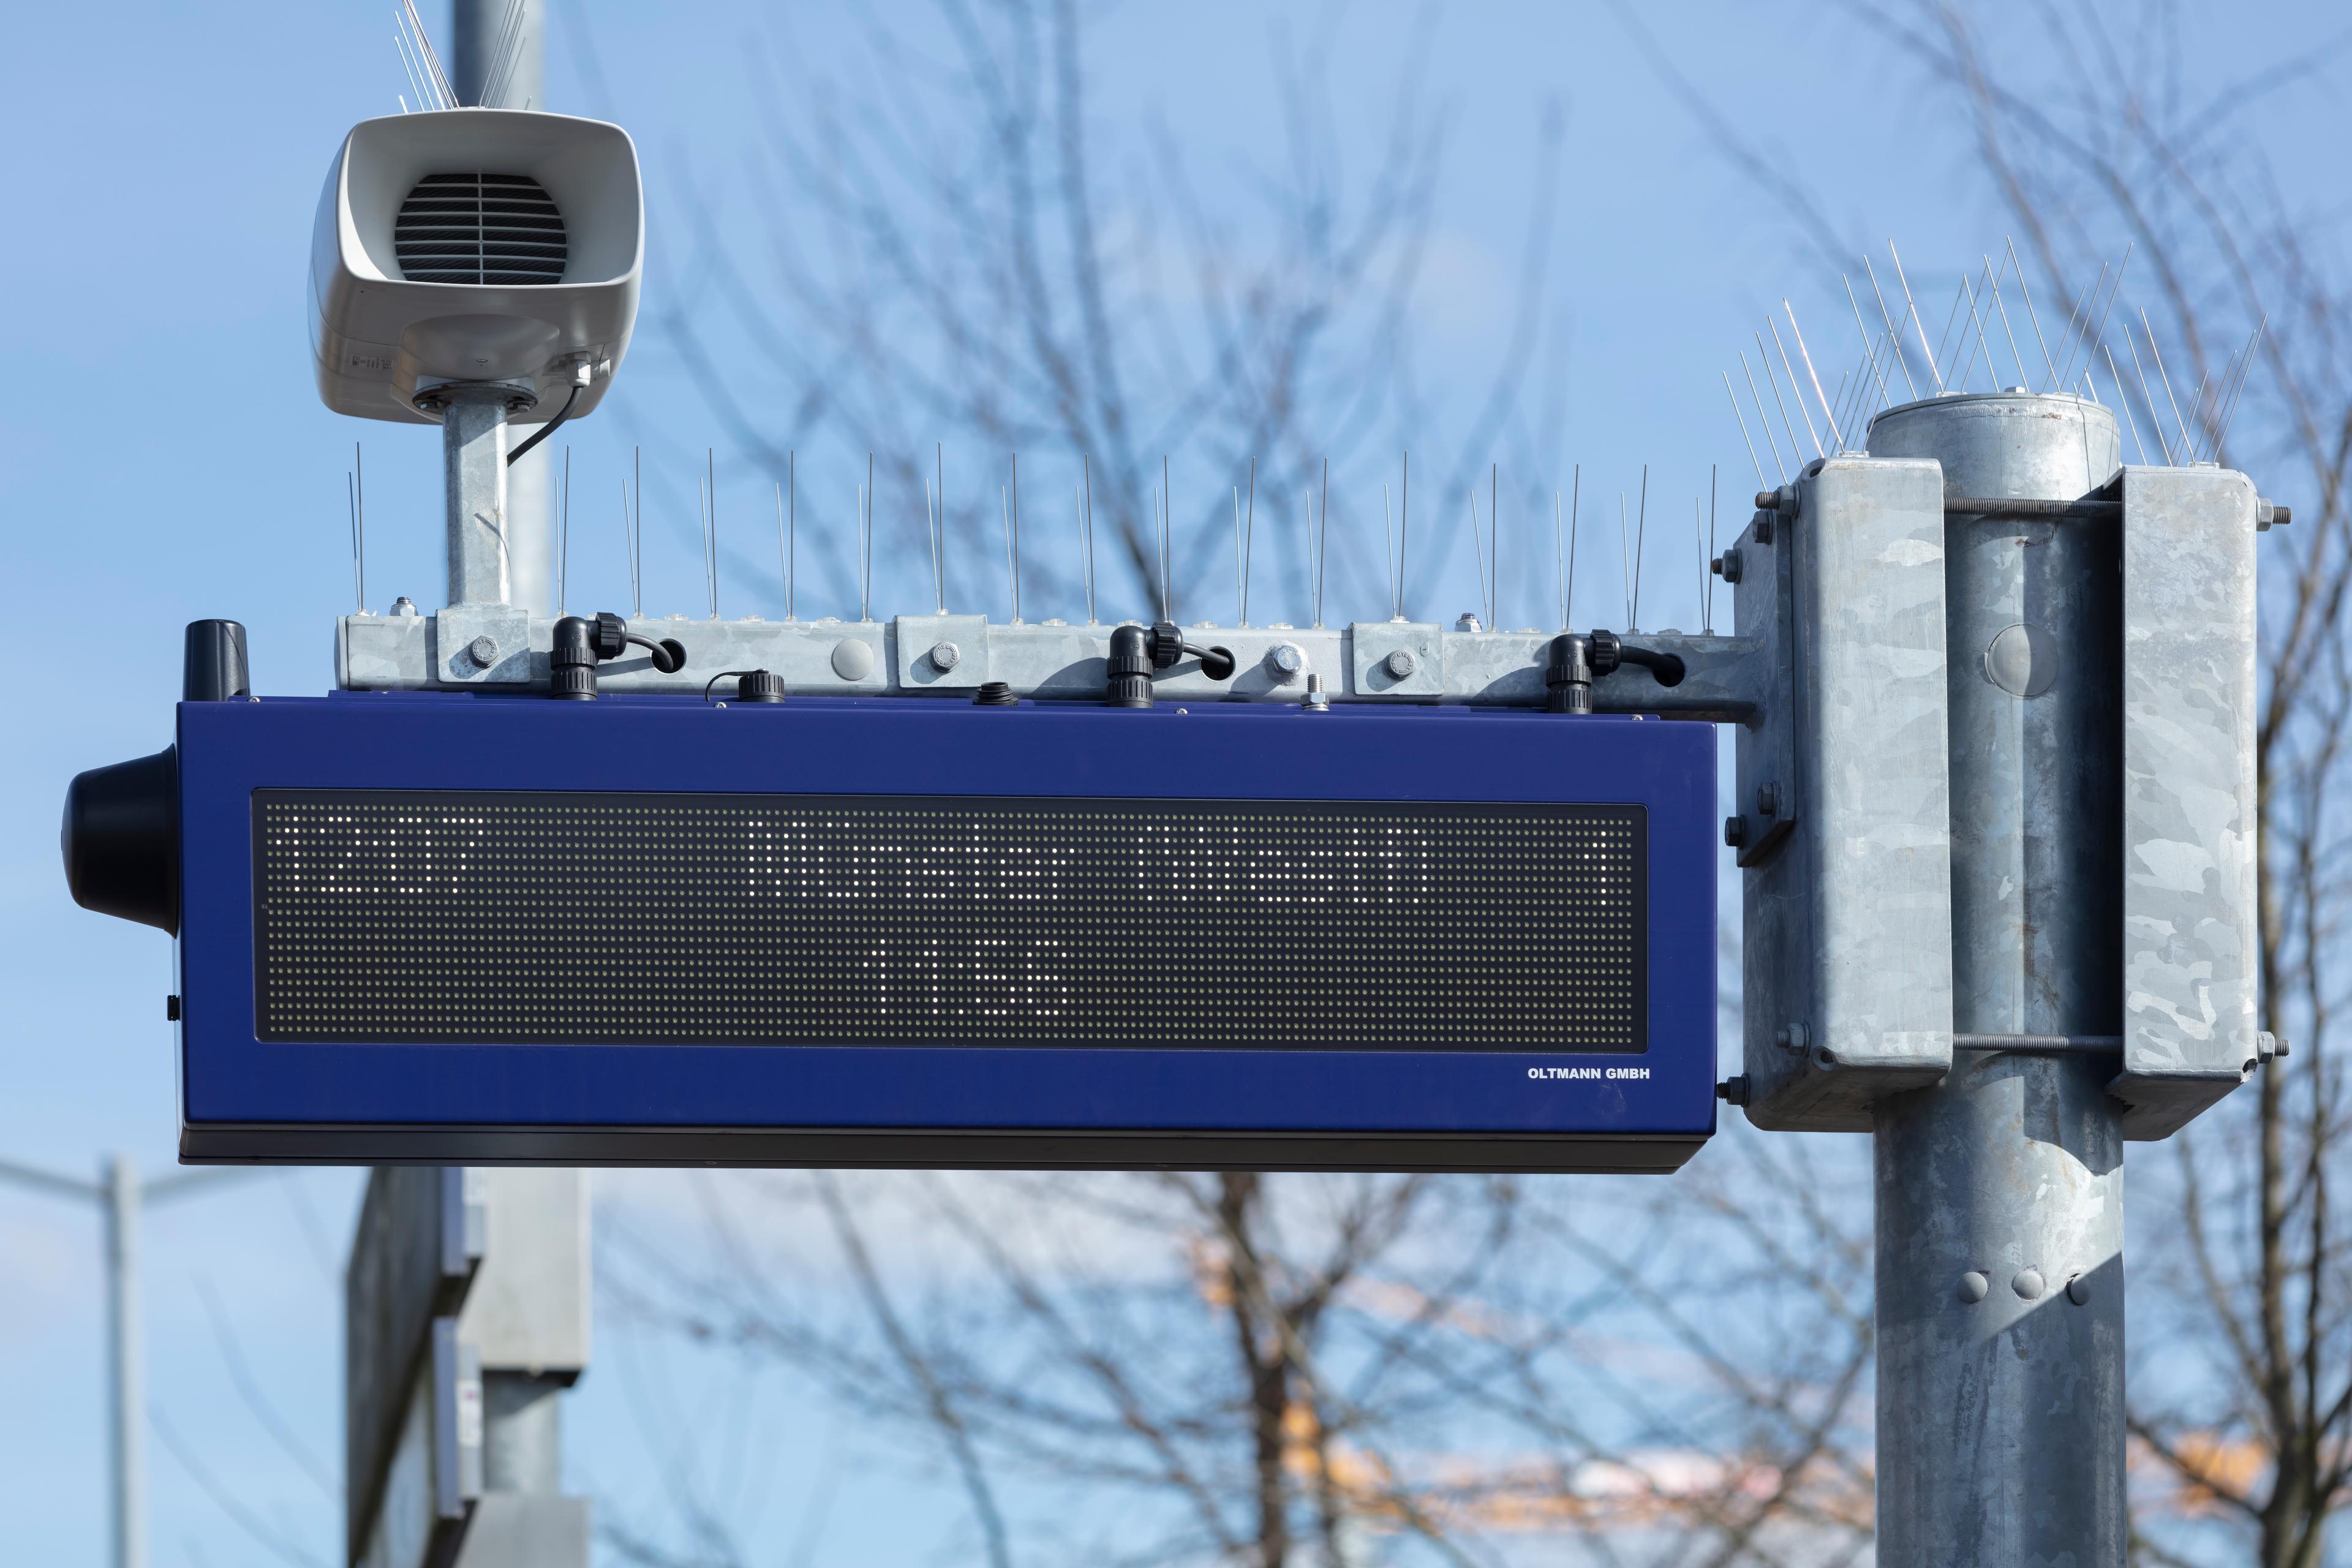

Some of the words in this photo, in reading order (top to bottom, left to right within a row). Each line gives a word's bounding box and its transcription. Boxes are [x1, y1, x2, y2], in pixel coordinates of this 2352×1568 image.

[276, 816, 483, 893] 12:07
[748, 821, 1074, 899] Münster
[1139, 826, 1427, 903] (Westf)
[1585, 831, 1606, 905] 1
[863, 939, 1067, 1015] 11:56
[1528, 1068, 1601, 1079] OLTMANN
[1605, 1068, 1650, 1079] GMBH
